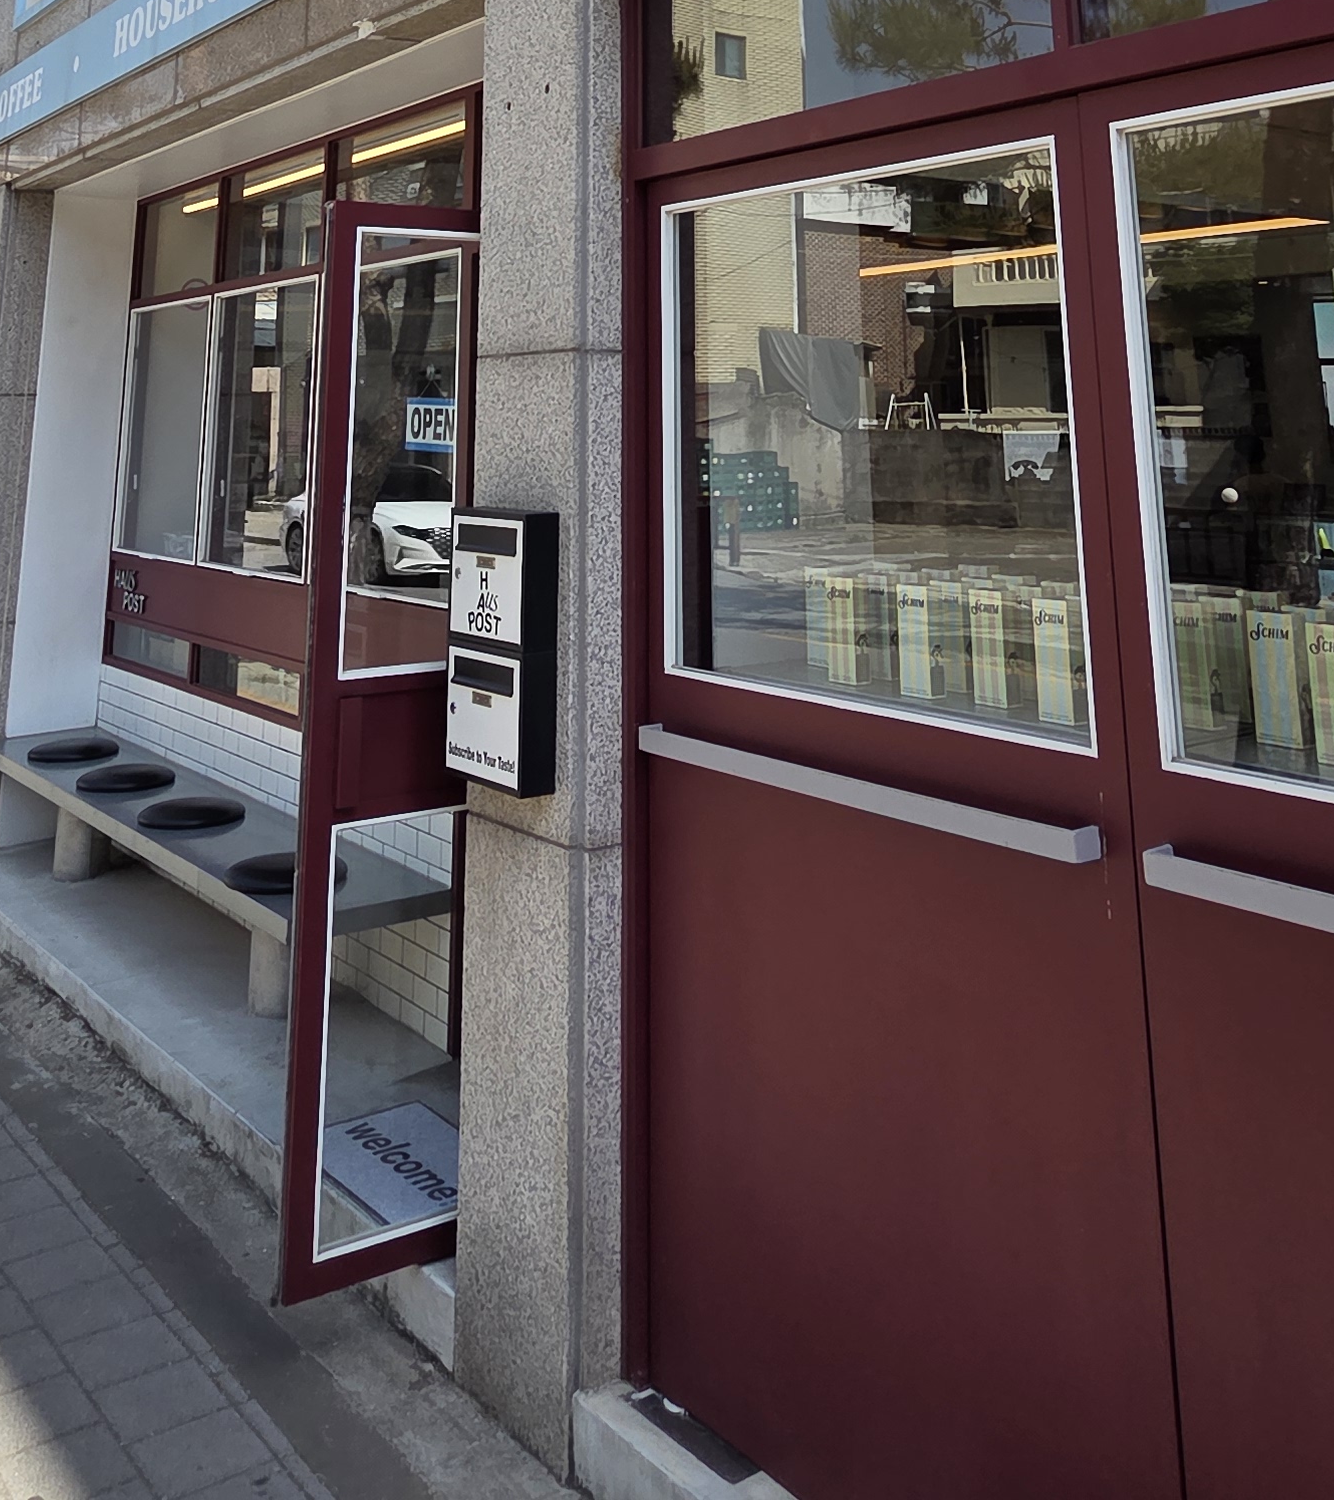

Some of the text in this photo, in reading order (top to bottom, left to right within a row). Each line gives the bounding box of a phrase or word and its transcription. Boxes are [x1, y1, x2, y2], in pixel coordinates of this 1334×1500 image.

[411, 406, 455, 442] OPEN
[122, 590, 145, 614] POST
[468, 611, 502, 636] POST
[1174, 616, 1200, 628] CHIM
[1250, 622, 1289, 641] SCHIM
[448, 741, 475, 762] Subscribe
[483, 751, 496, 768] Your
